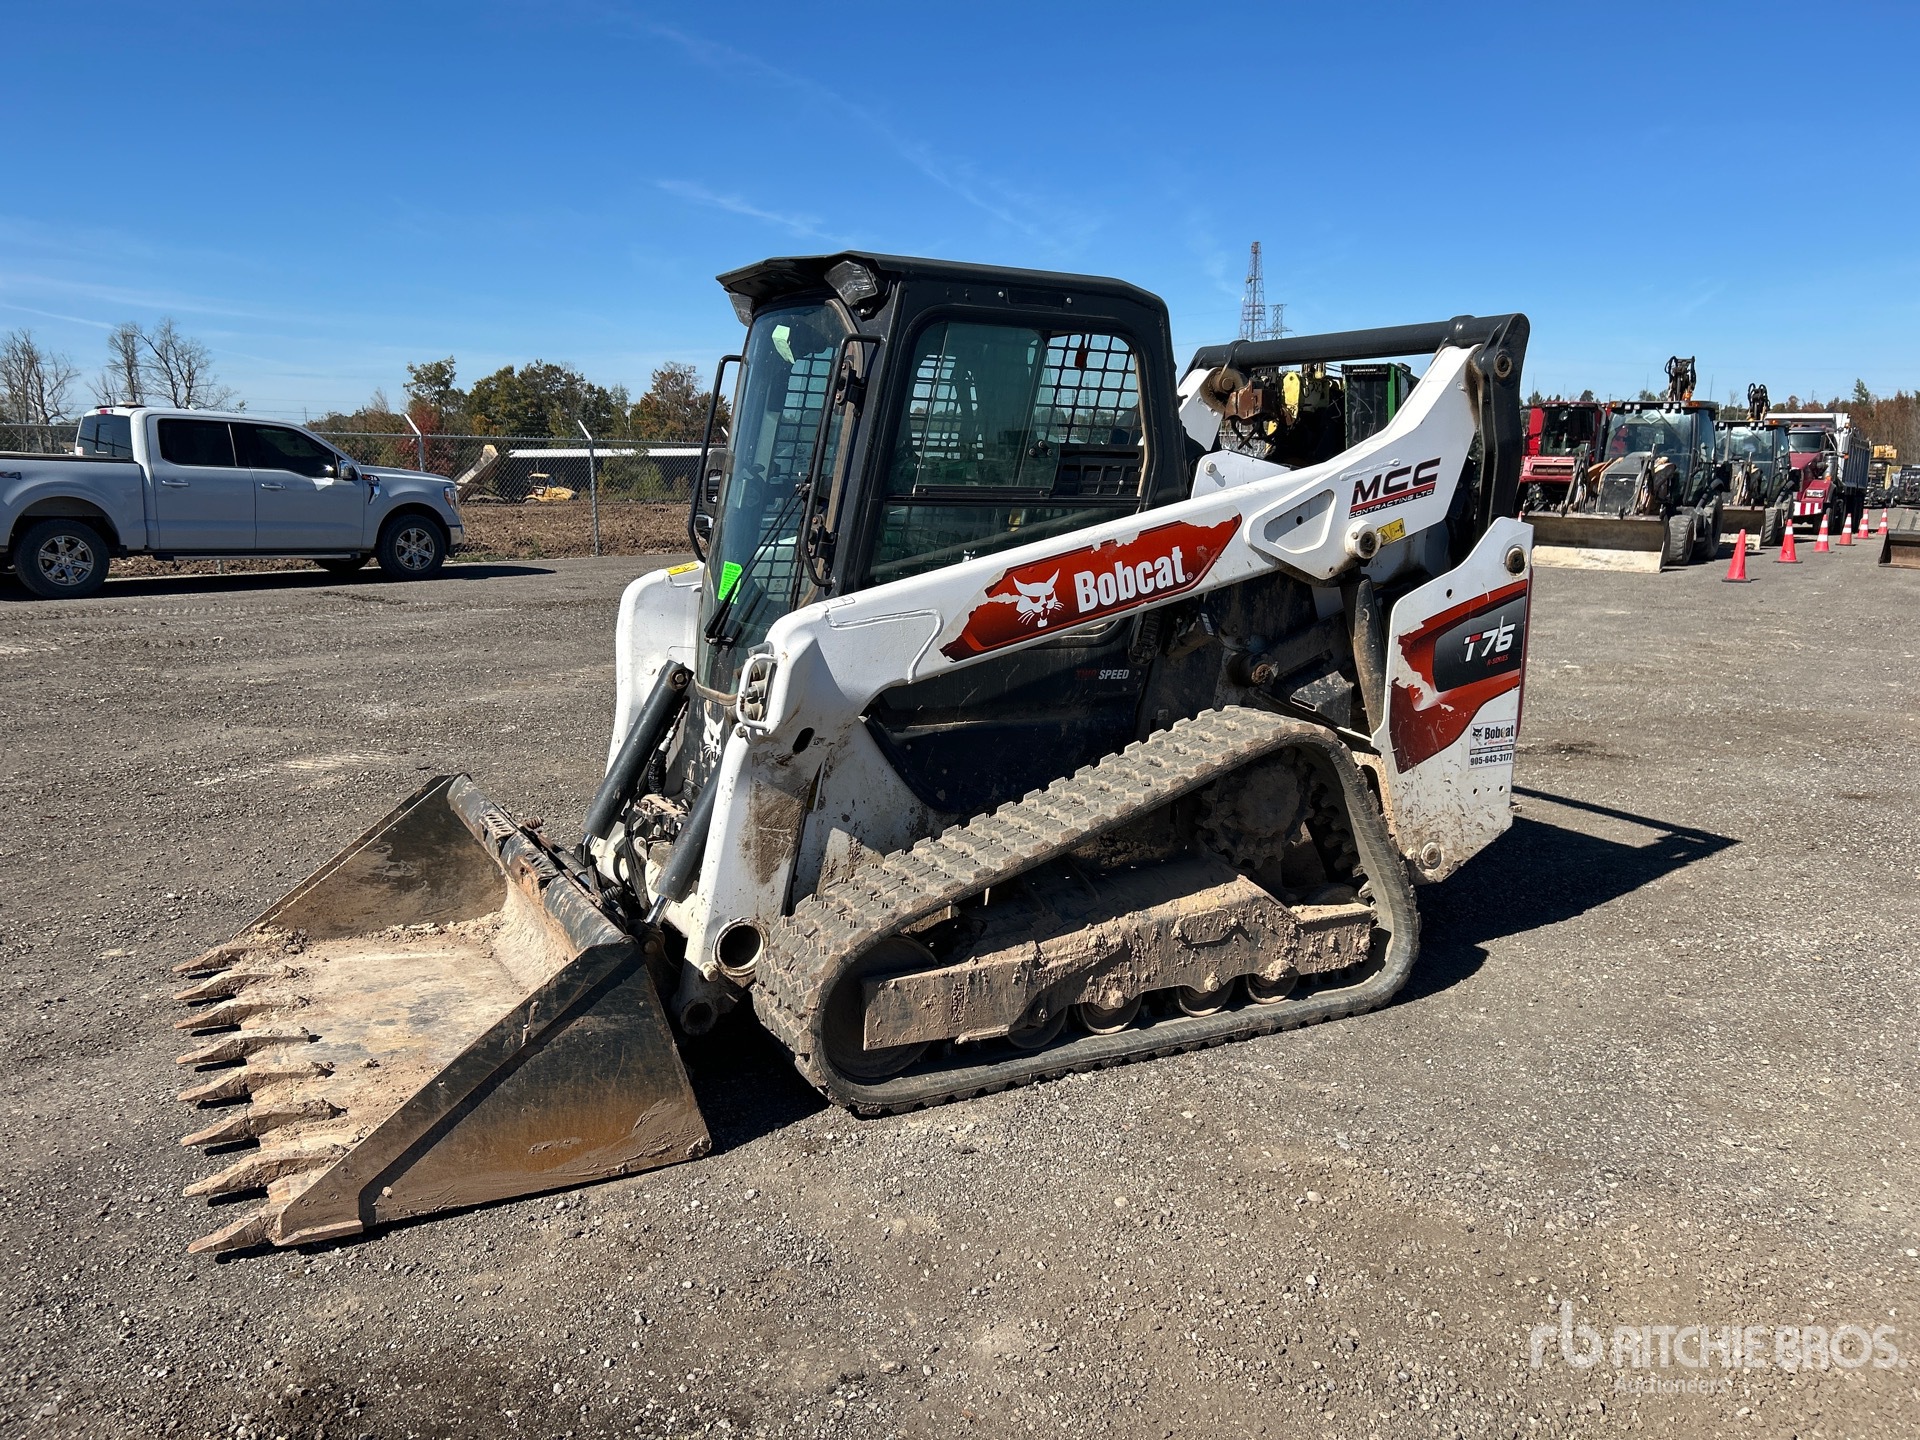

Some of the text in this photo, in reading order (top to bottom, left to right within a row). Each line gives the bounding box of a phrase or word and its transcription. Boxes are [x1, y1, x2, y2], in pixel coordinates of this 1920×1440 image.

[1351, 457, 1441, 506] MCC
[1349, 495, 1414, 518] CONTRACTING
[1074, 546, 1186, 613] Bobcat
[1463, 623, 1515, 662] T76
[1099, 669, 1130, 680] SPEED
[1470, 753, 1512, 766] 905-643-3177
